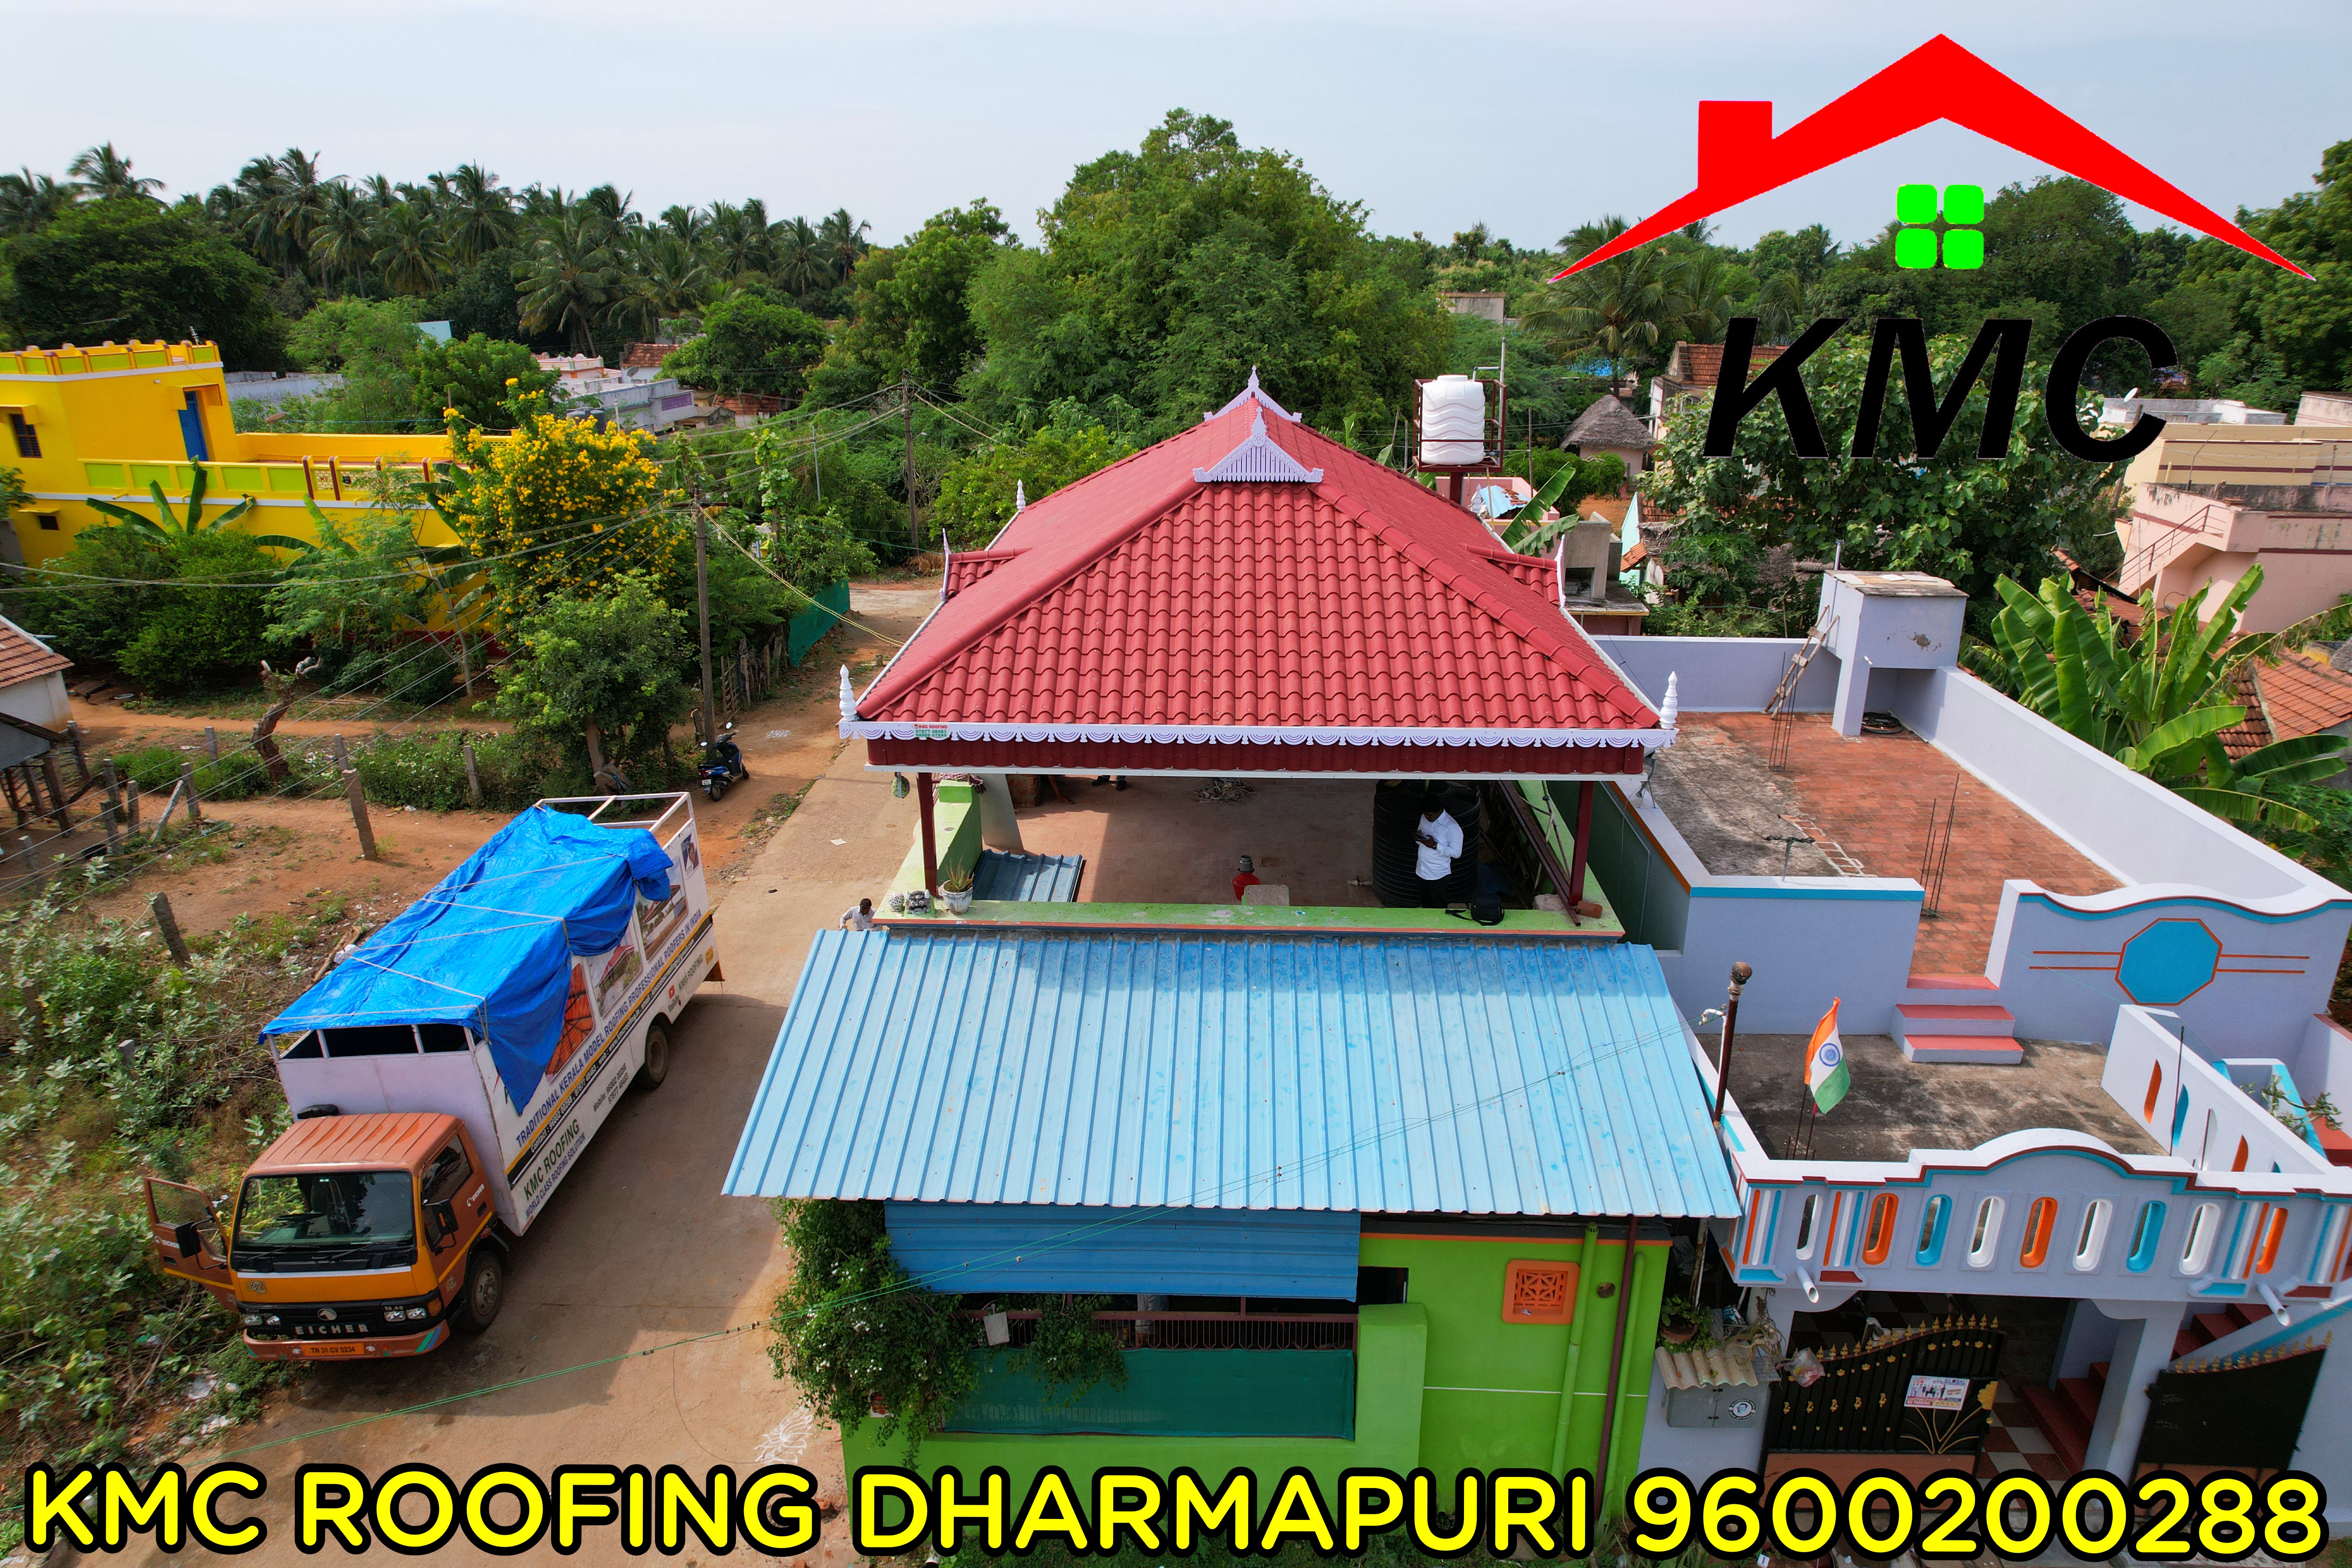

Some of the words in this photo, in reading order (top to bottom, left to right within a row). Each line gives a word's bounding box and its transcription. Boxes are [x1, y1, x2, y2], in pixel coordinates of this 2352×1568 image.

[687, 954, 703, 979] ROOFING
[516, 1088, 559, 1148] TRADITIONAL
[559, 1057, 583, 1093] KERALA
[583, 1032, 603, 1063] MODEL
[604, 1001, 628, 1036] ROOFING
[628, 956, 664, 1006] PROFESSIONAL
[664, 929, 685, 961] ROOFERS
[684, 923, 689, 934] IN
[689, 909, 701, 927] INDIA
[530, 1129, 547, 1153] Contact
[548, 1110, 560, 1129] 96002
[560, 1096, 572, 1114] 00288
[574, 1078, 586, 1096] 97877
[585, 1065, 596, 1081] 48483
[598, 1051, 606, 1065] web
[641, 995, 650, 1009] email
[593, 1090, 606, 1112] Mobile:
[605, 1076, 617, 1094] 96002
[607, 1086, 619, 1104] 97877
[523, 1166, 545, 1201] KMC
[542, 1117, 580, 1174] ROOFING
[524, 1195, 540, 1219] WORLD
[539, 1178, 552, 1199] CLASS
[551, 1156, 568, 1182] ROOFING
[567, 1132, 585, 1160] SOLUTION
[472, 1184, 485, 1202] EICHER
[295, 1323, 369, 1335] EICHER
